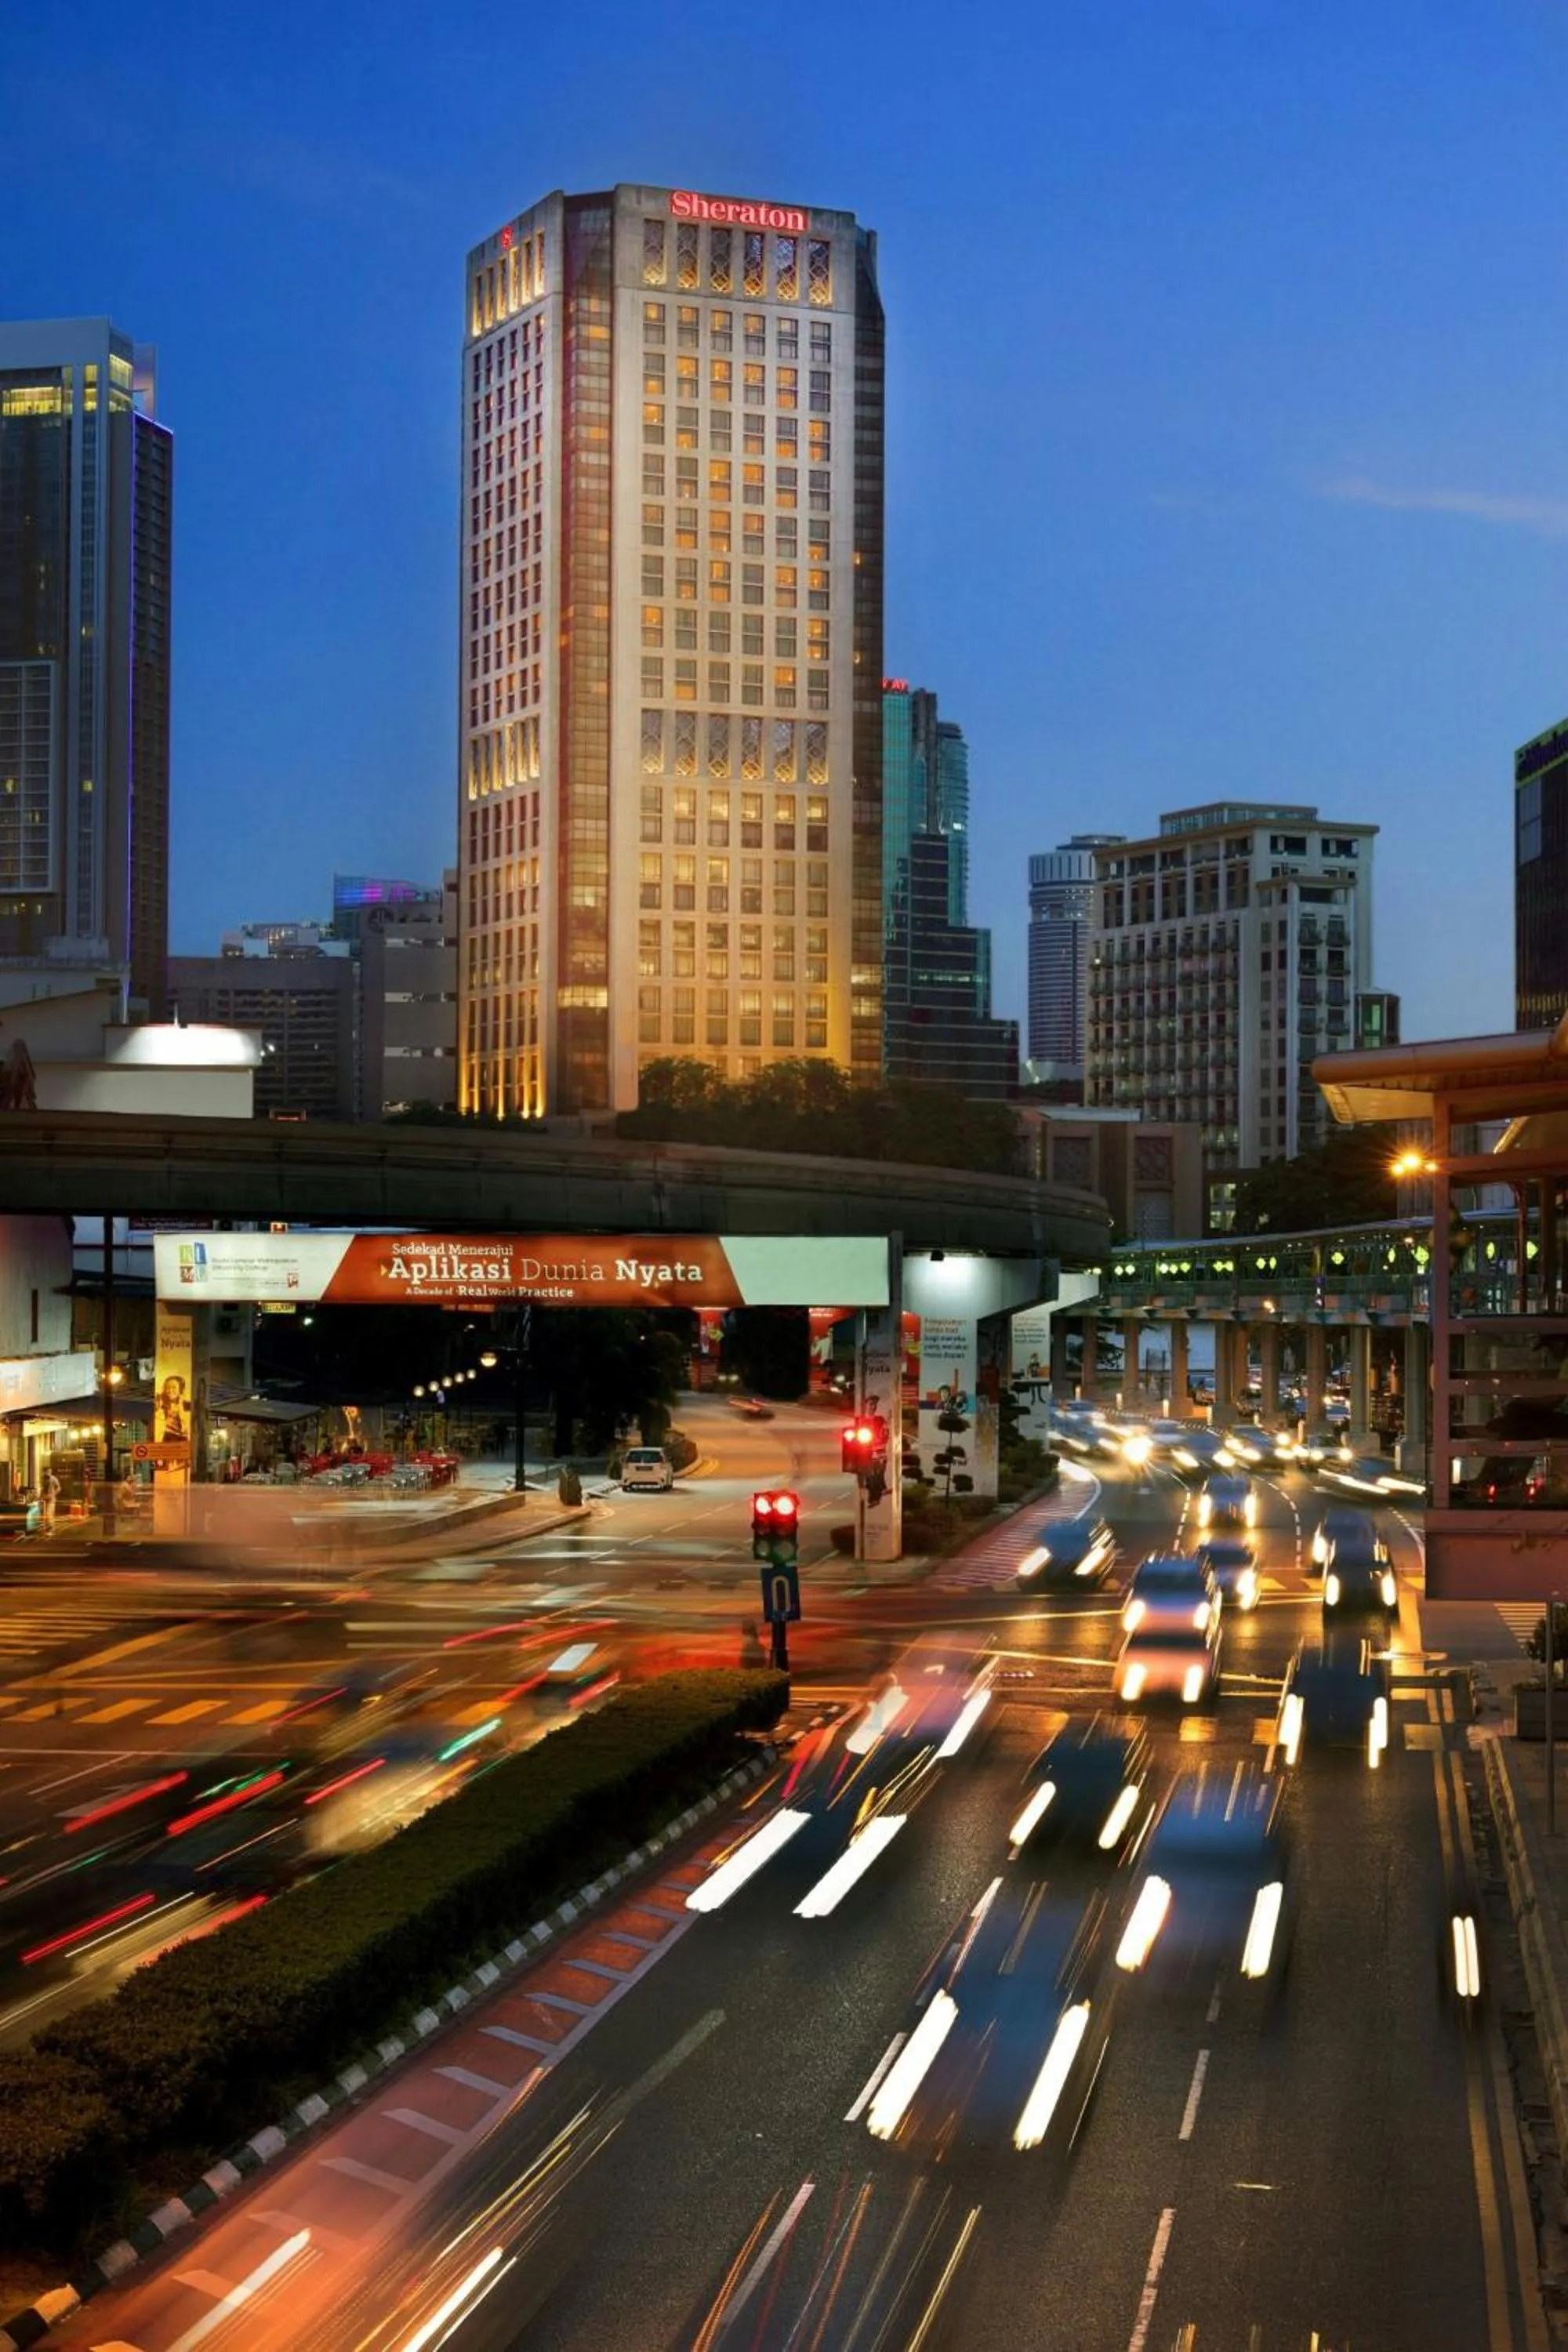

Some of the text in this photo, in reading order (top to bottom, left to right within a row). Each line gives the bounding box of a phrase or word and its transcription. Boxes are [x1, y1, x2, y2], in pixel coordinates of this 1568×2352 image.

[671, 191, 804, 230] Sheraton
[392, 1242, 514, 1259] Sedekad Menerajui
[389, 1255, 703, 1287] Aplikasi Dunia Nyata
[518, 1287, 574, 1298] Practice
